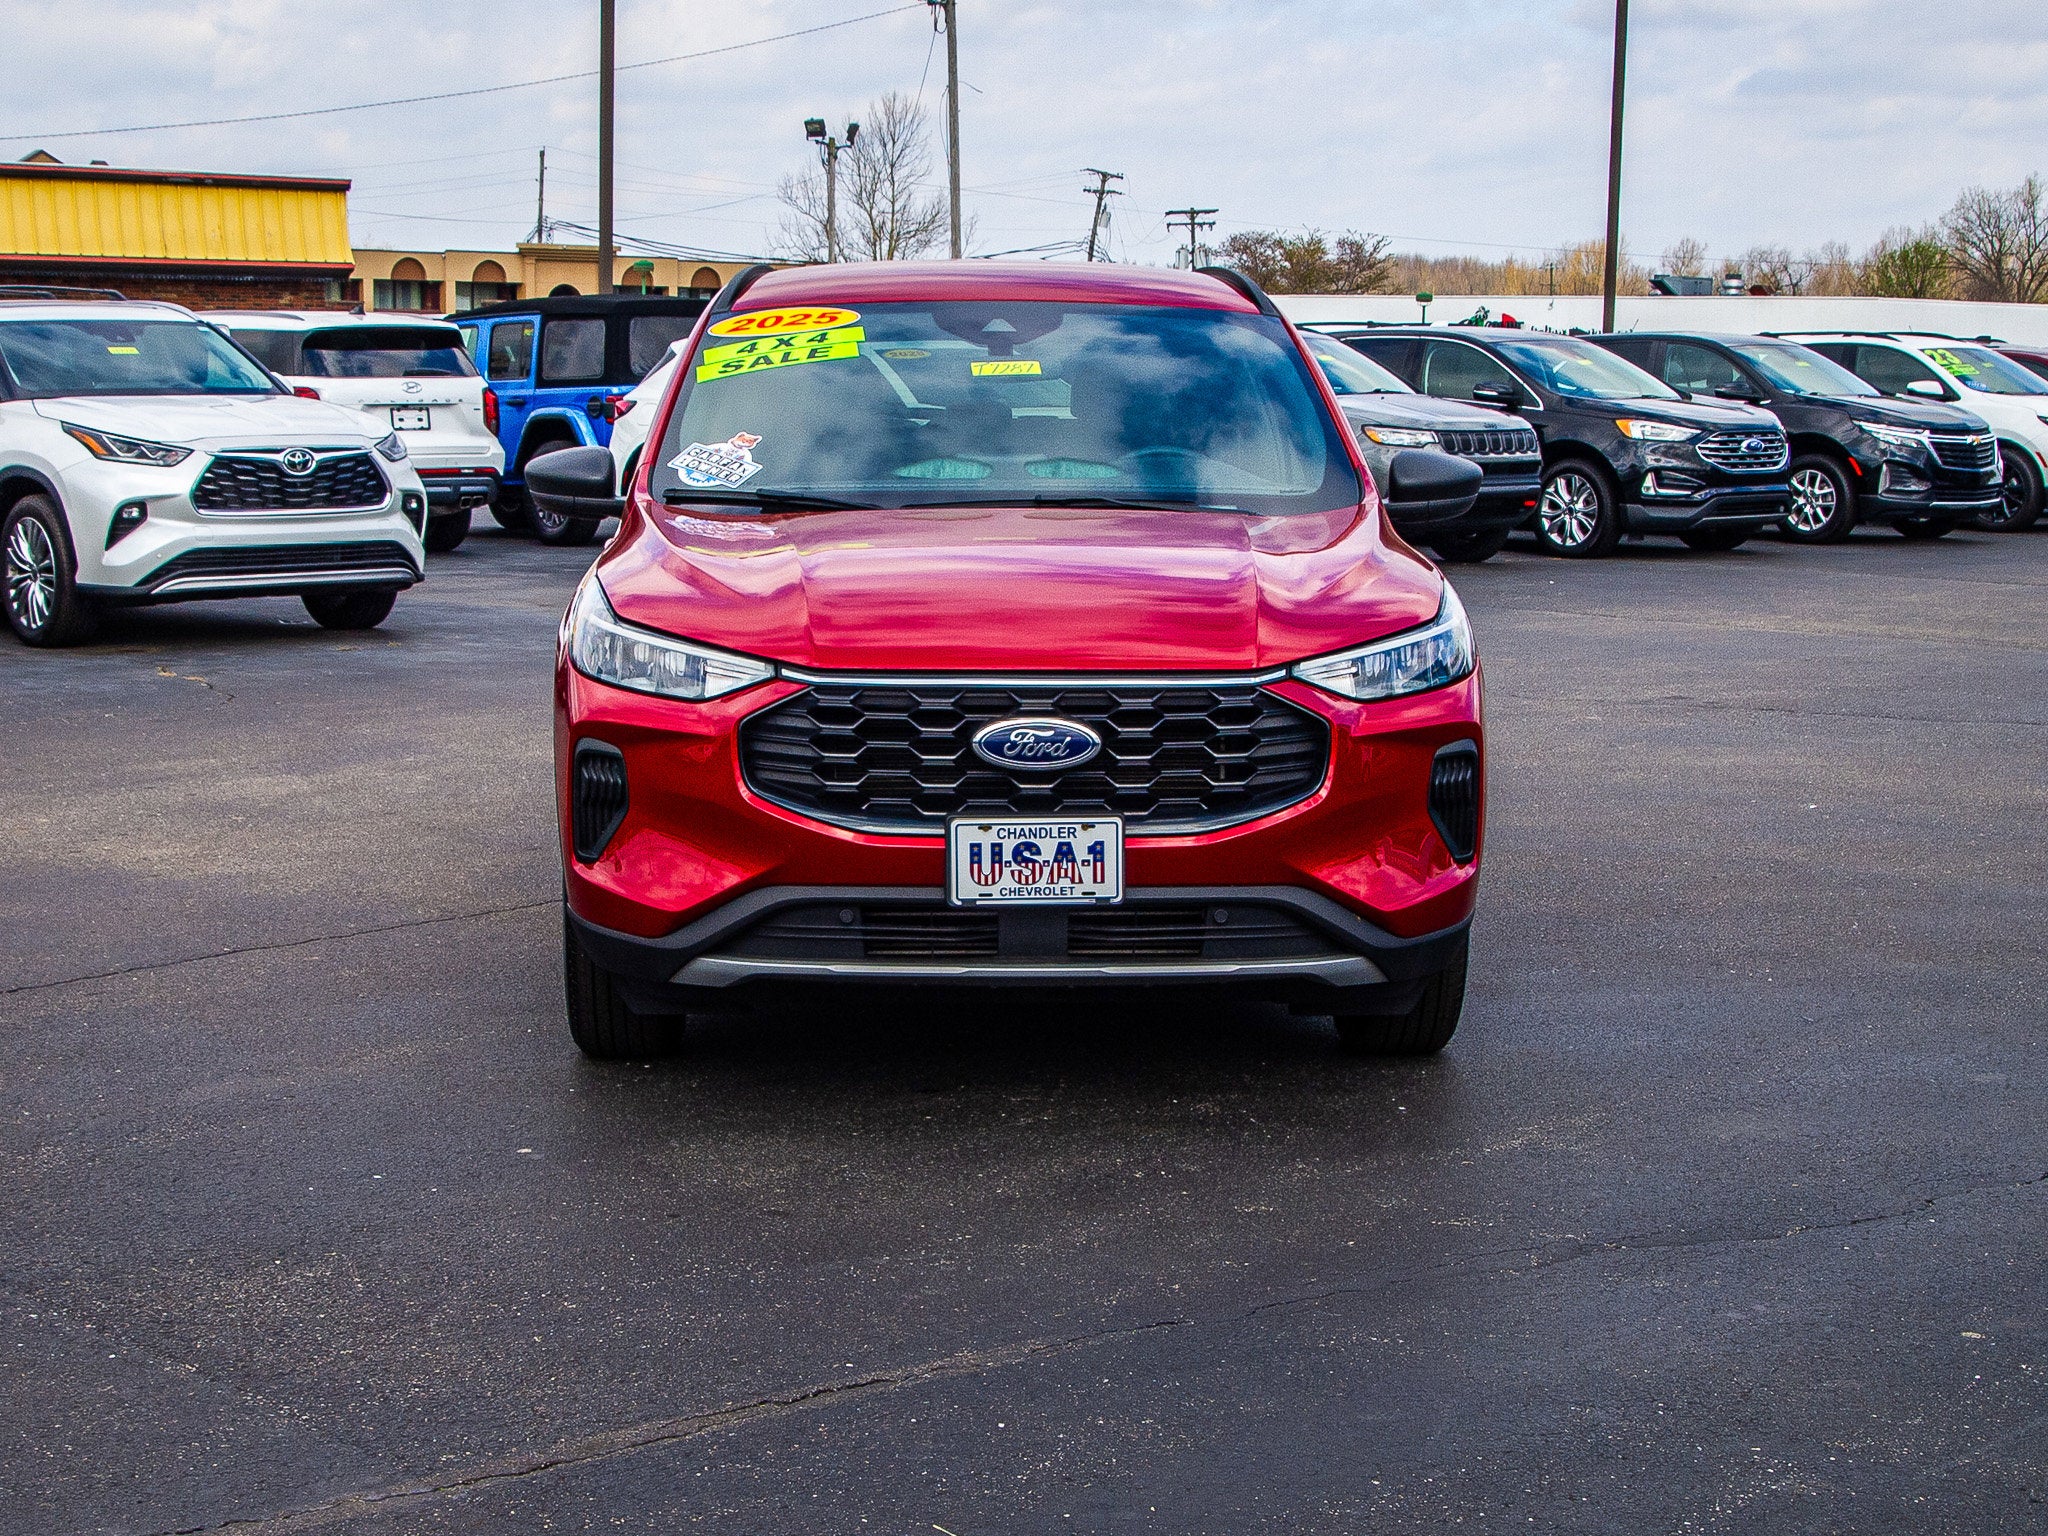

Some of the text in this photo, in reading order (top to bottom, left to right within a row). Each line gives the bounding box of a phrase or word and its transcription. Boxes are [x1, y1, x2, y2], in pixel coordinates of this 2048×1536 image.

[726, 311, 842, 334] 2025
[718, 346, 833, 374] SALE
[688, 447, 750, 475] CARFAX
[1003, 728, 1071, 758] Ford
[996, 826, 1078, 840] CHANDLER
[999, 886, 1076, 898] CHEVROLET
